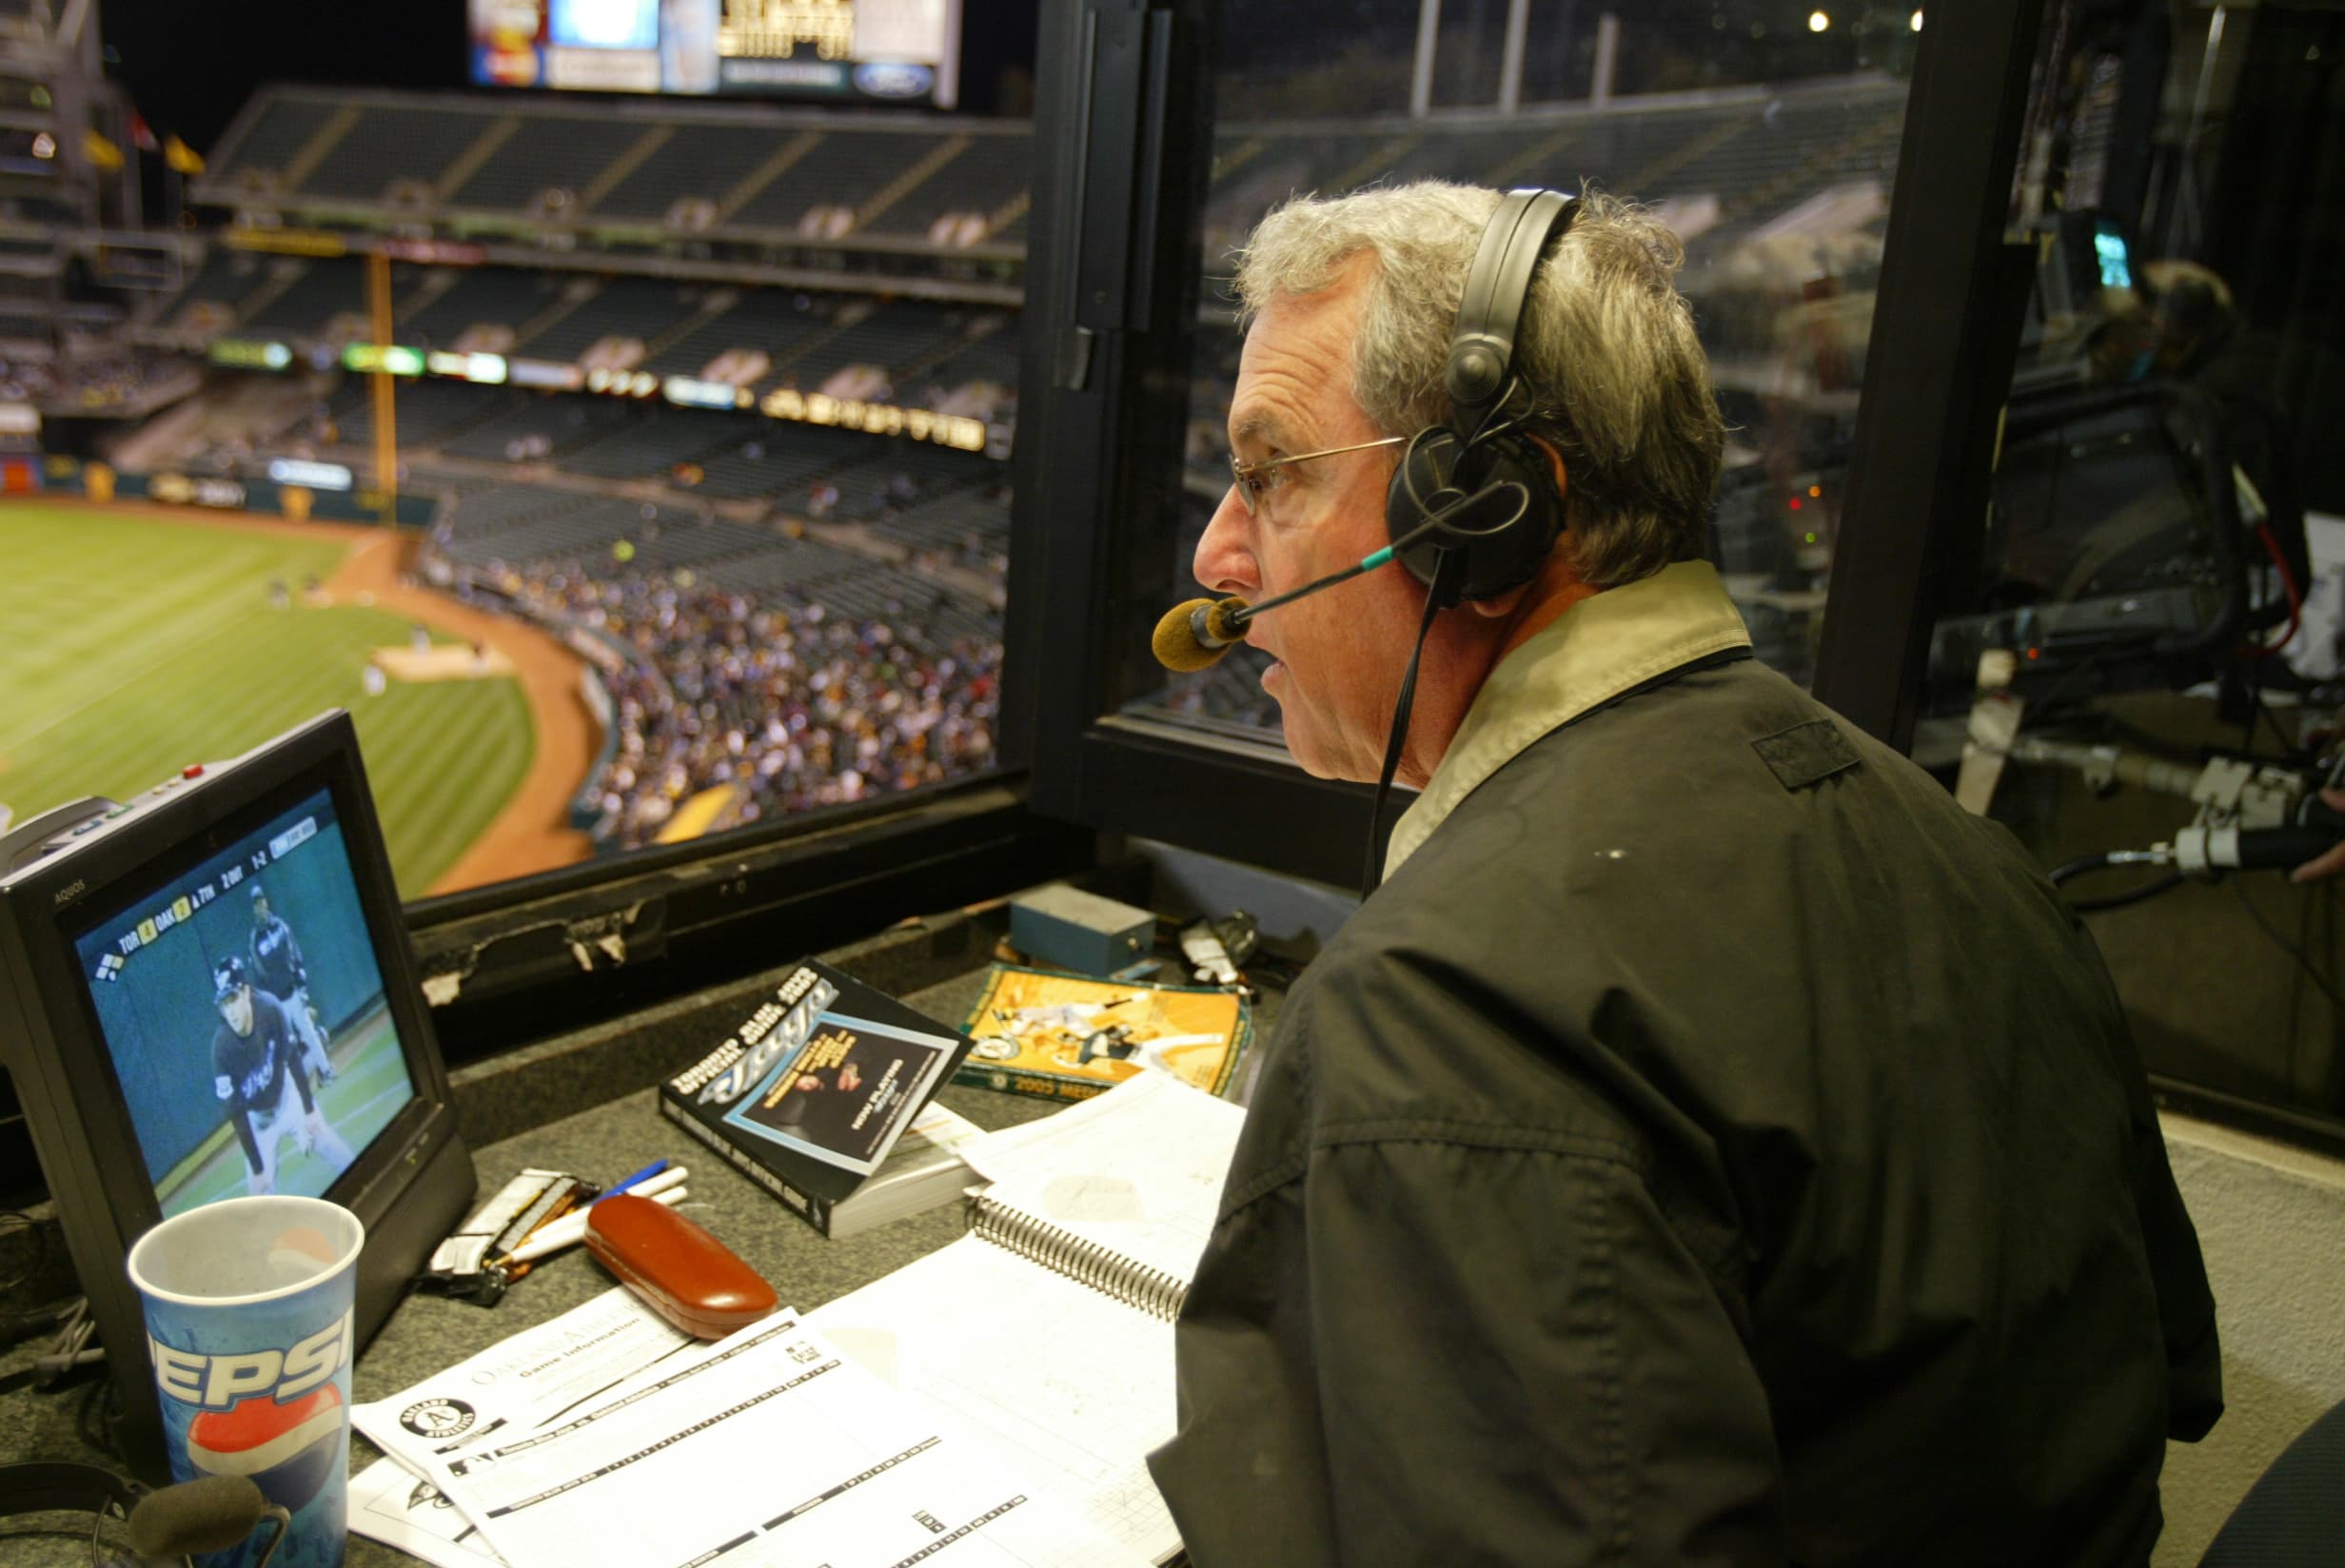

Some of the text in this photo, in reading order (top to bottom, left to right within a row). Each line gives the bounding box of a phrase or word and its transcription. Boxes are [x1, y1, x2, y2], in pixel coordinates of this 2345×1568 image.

[54, 879, 86, 905] AQUOS
[118, 931, 141, 954] TOR
[155, 908, 175, 932] OAK
[251, 851, 267, 870] 1-2
[670, 1038, 739, 1088] TORONTO
[739, 1002, 774, 1036] BLUE
[678, 1048, 746, 1094] OFFICIAL
[851, 1102, 874, 1130] NOW
[869, 1059, 903, 1104] PLAYING
[1015, 1076, 1054, 1094] 2005
[147, 1305, 354, 1406] EPSI
[520, 1357, 562, 1378] Game
[562, 1318, 641, 1358] Information
